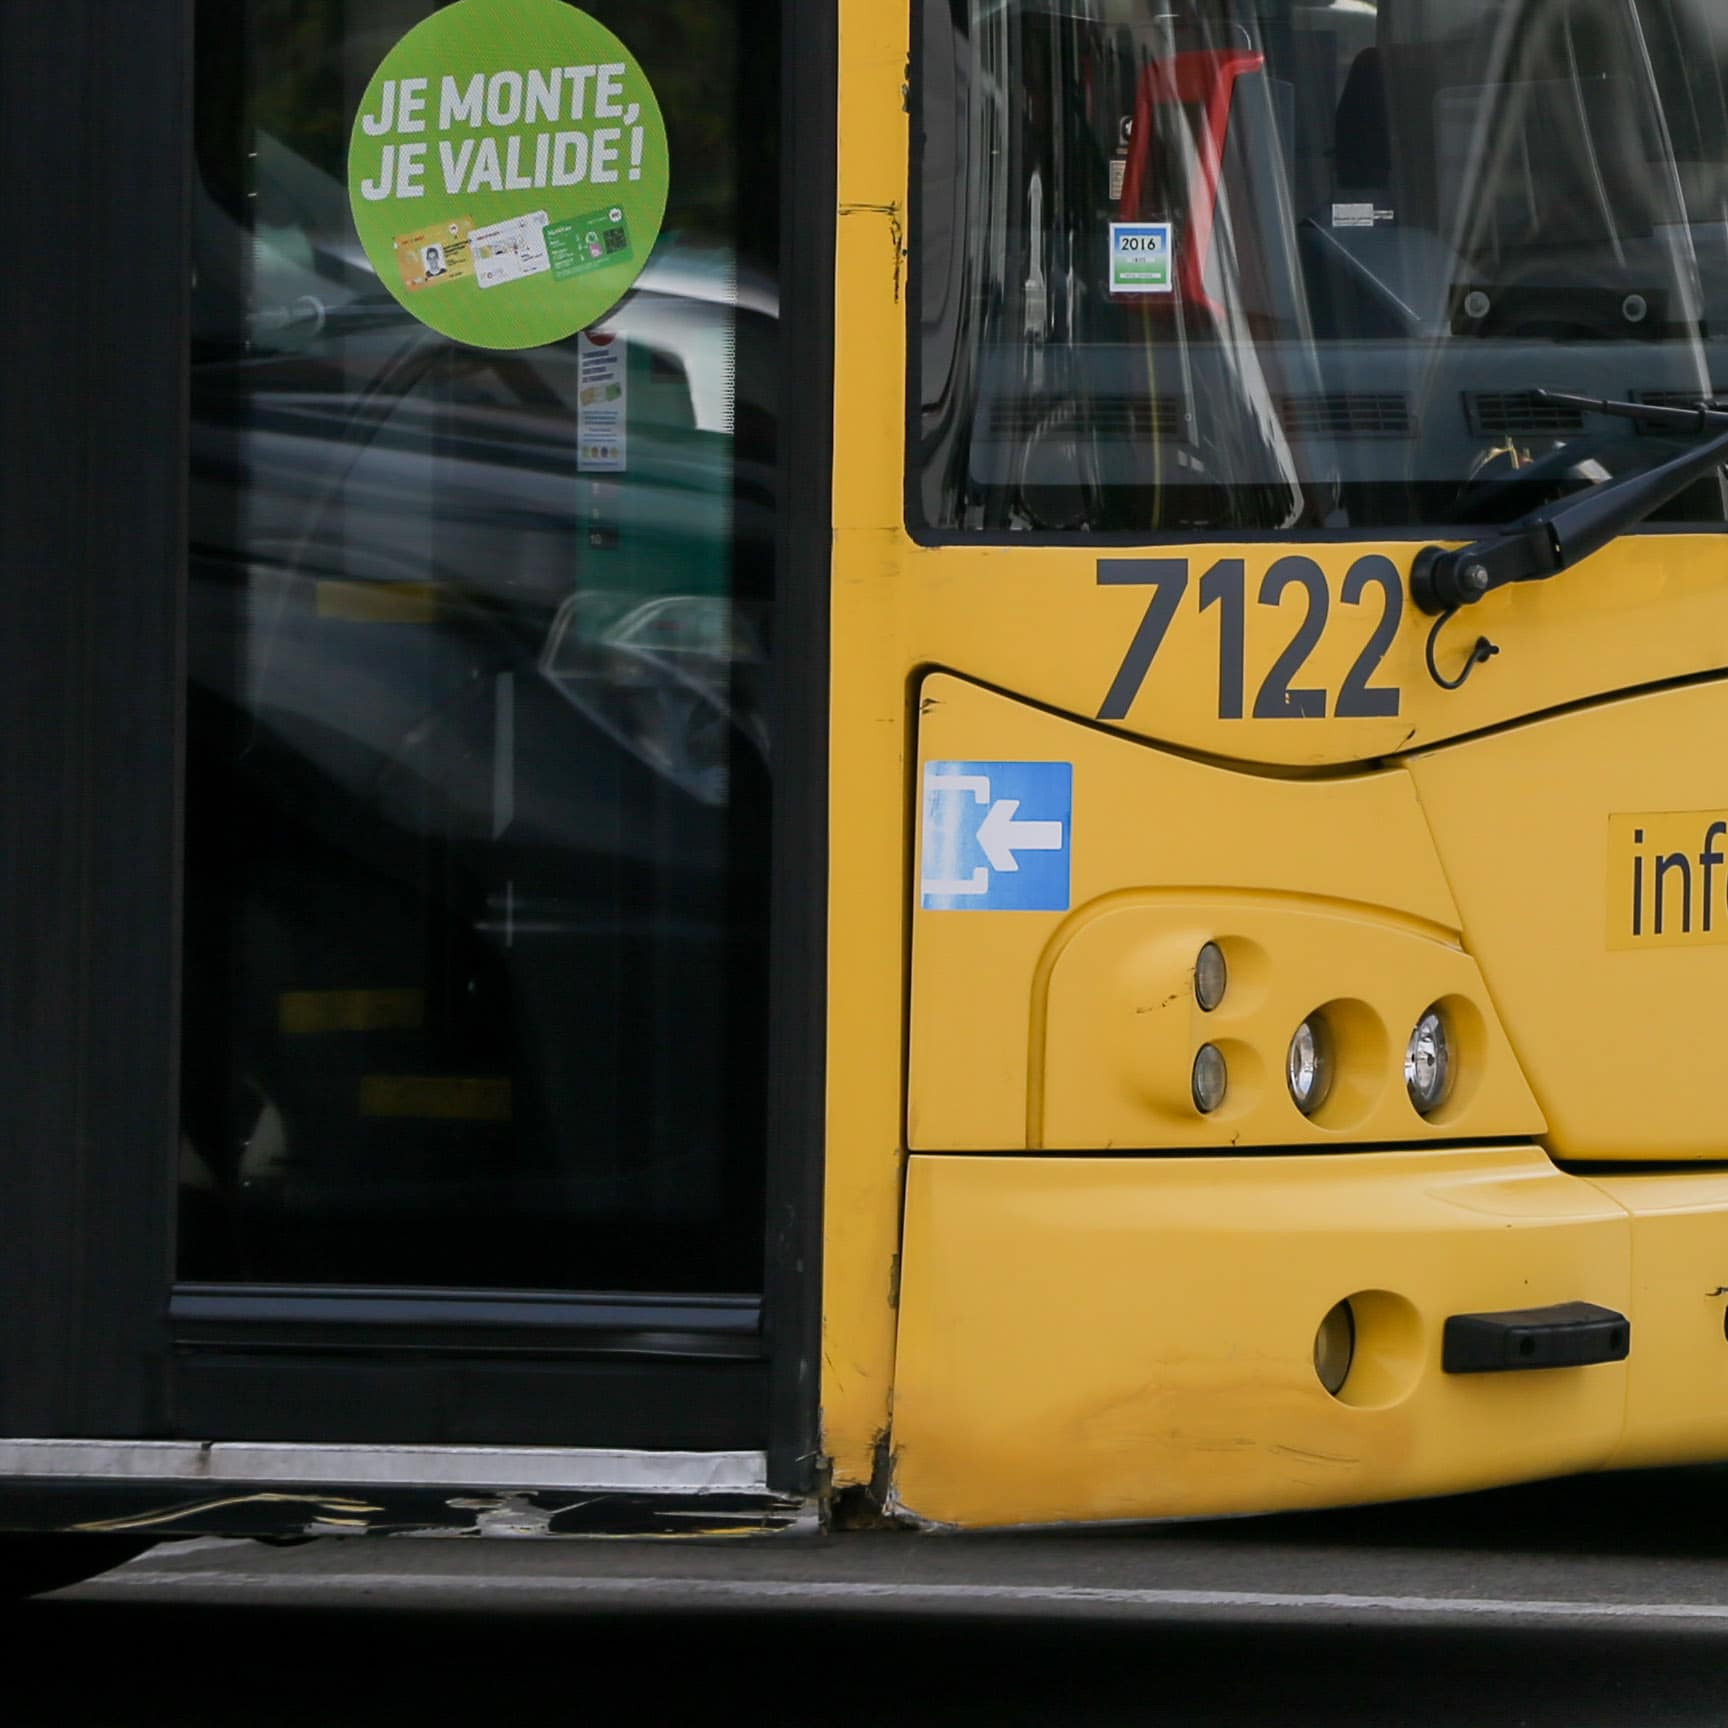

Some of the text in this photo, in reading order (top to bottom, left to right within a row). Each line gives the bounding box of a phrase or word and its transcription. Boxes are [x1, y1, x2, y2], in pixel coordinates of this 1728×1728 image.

[362, 63, 640, 136] JE MONTE,
[361, 142, 425, 201] JE
[1121, 237, 1156, 251] 2016
[1095, 554, 1403, 720] 7122
